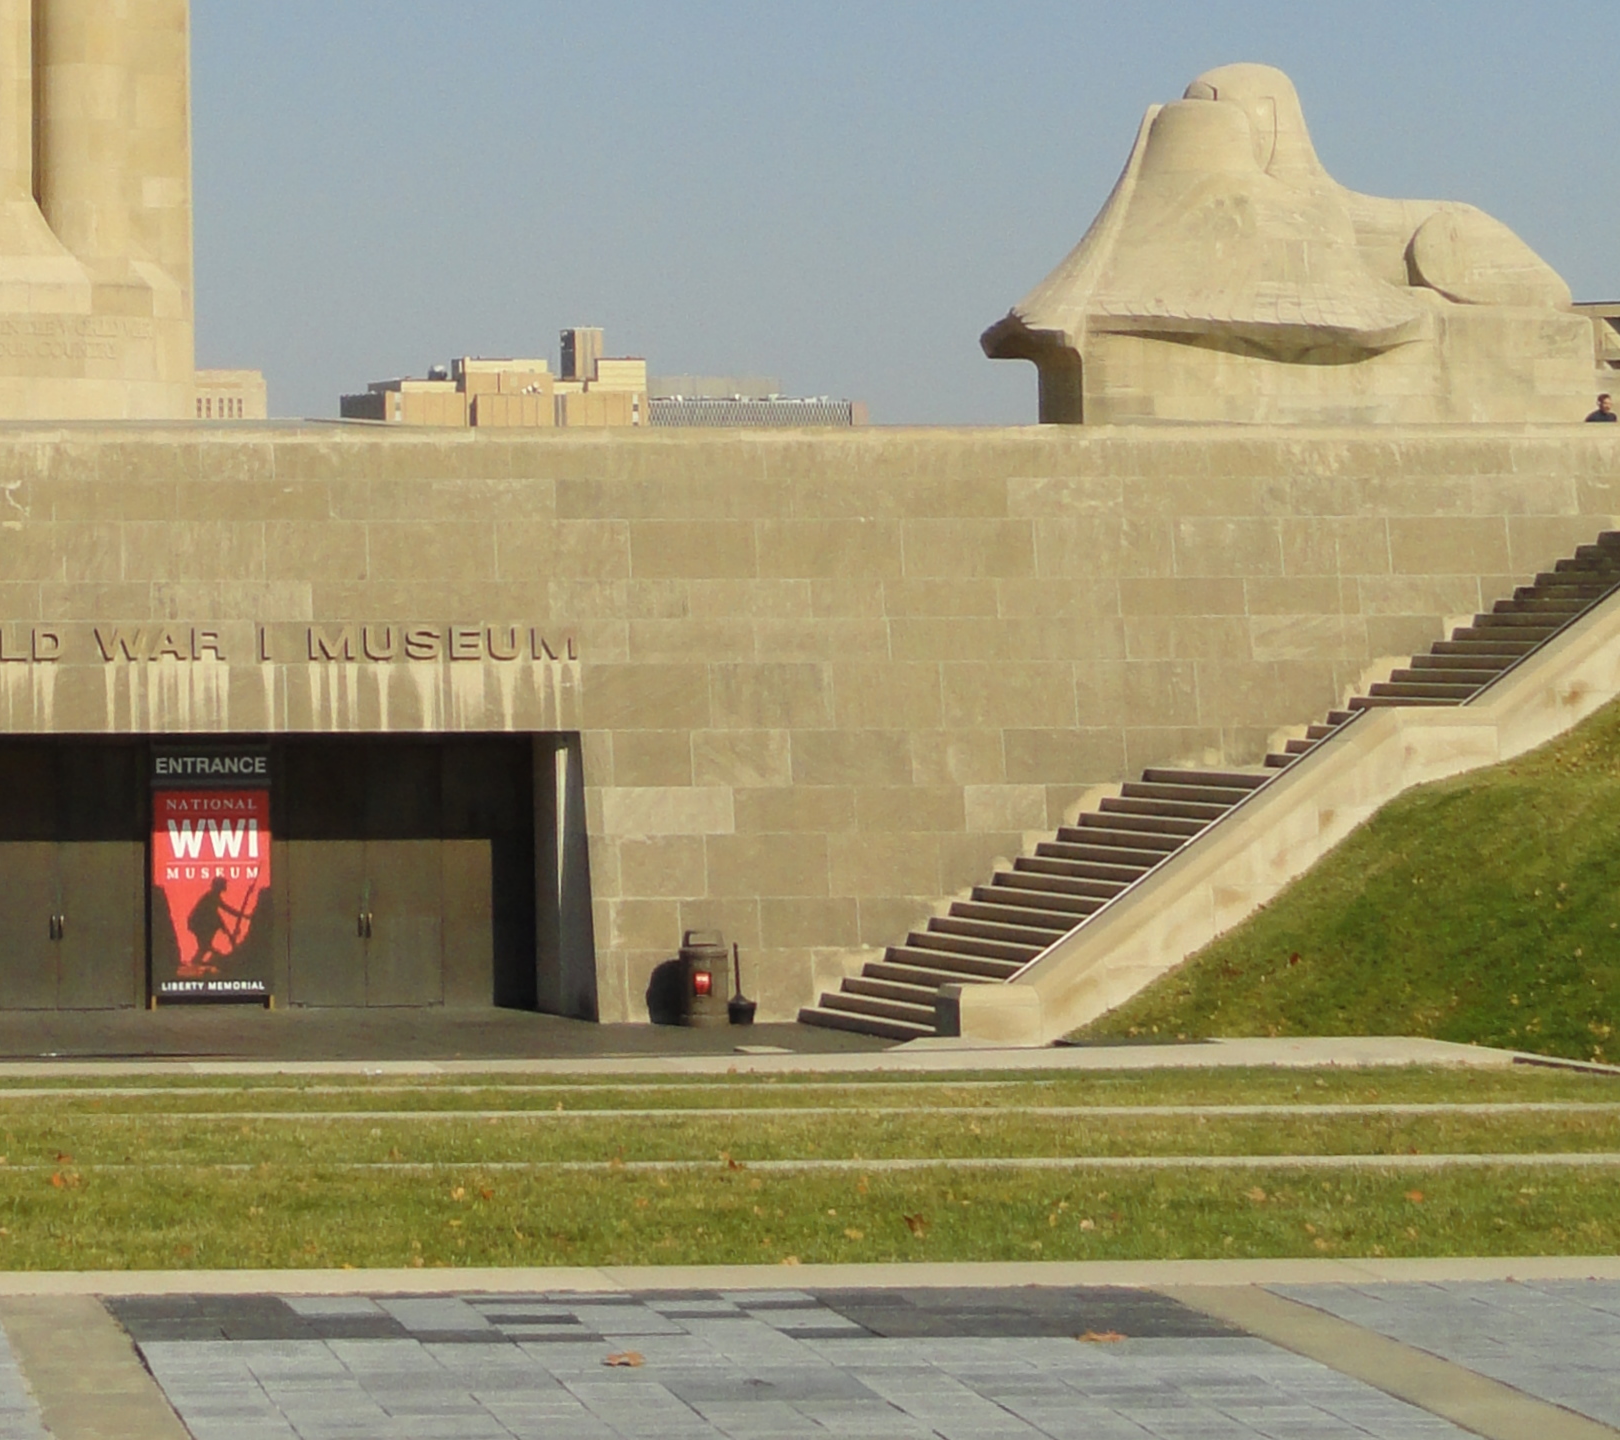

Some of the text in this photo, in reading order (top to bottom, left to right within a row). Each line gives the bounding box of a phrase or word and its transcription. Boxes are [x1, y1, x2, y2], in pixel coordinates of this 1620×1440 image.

[92, 627, 227, 662] WAR
[259, 626, 272, 662] I
[306, 625, 579, 662] MUSEUM
[155, 757, 267, 774] ENTRANCE
[166, 799, 258, 810] NATIONAL
[167, 819, 259, 858] WWI
[166, 867, 259, 879] MUSEUM
[161, 981, 265, 991] LIBERTY MEMORIAL
